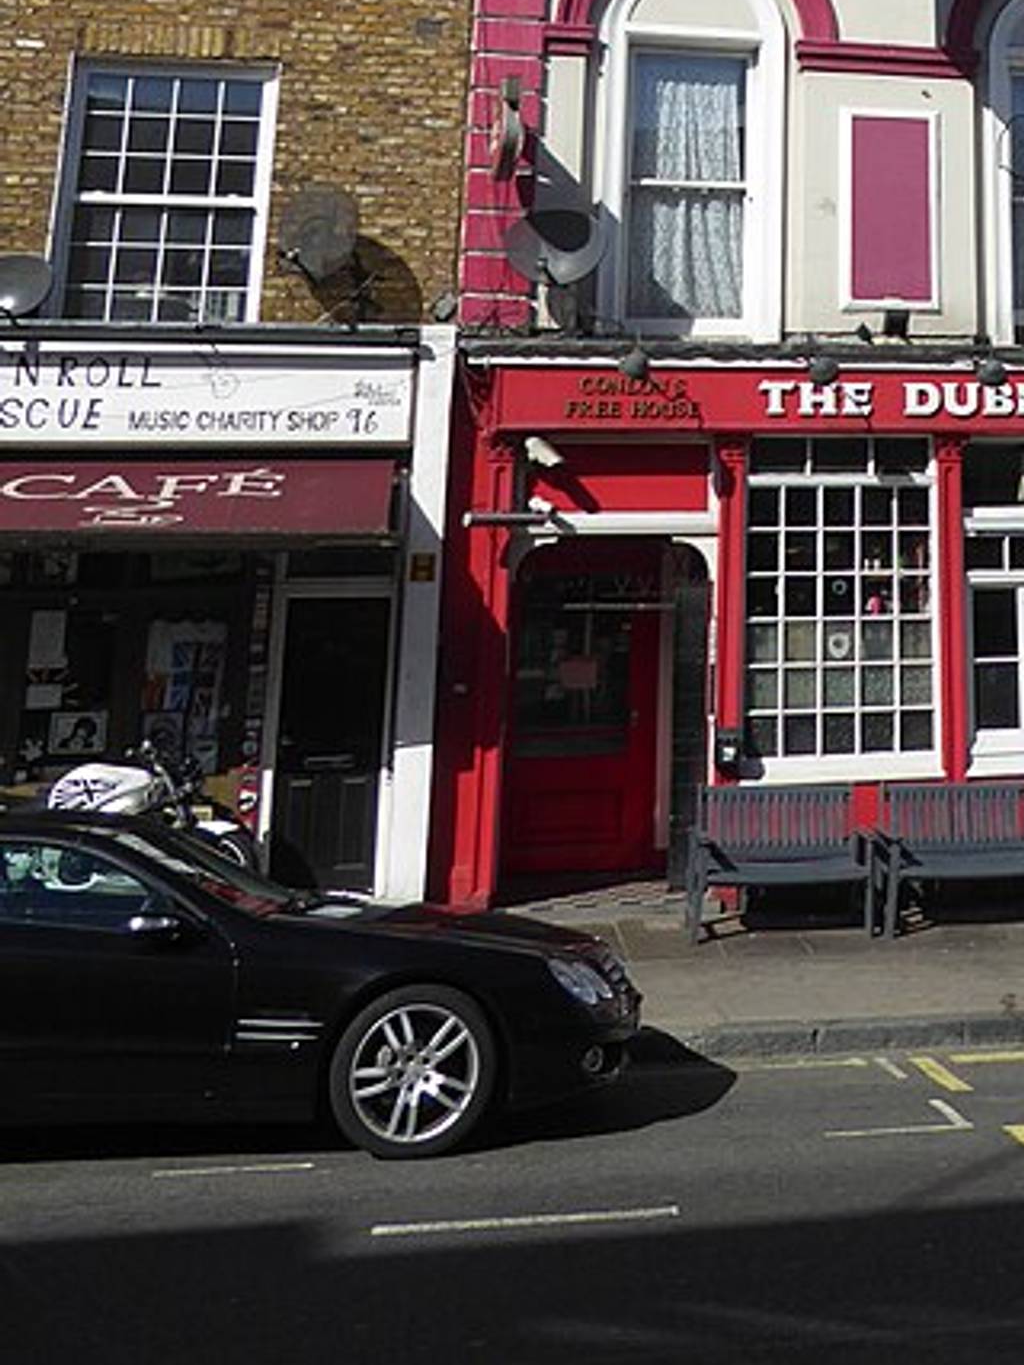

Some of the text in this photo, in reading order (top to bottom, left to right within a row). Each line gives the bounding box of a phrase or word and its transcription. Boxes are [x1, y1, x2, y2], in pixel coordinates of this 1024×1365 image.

[57, 356, 161, 387] ROLL
[565, 400, 701, 420] FREE HOUSE
[758, 380, 872, 416] THE
[127, 410, 191, 432] MUSIC
[195, 410, 282, 432] CHARITY
[286, 411, 340, 432] SHOP
[0, 468, 284, 500] CAFÉ
